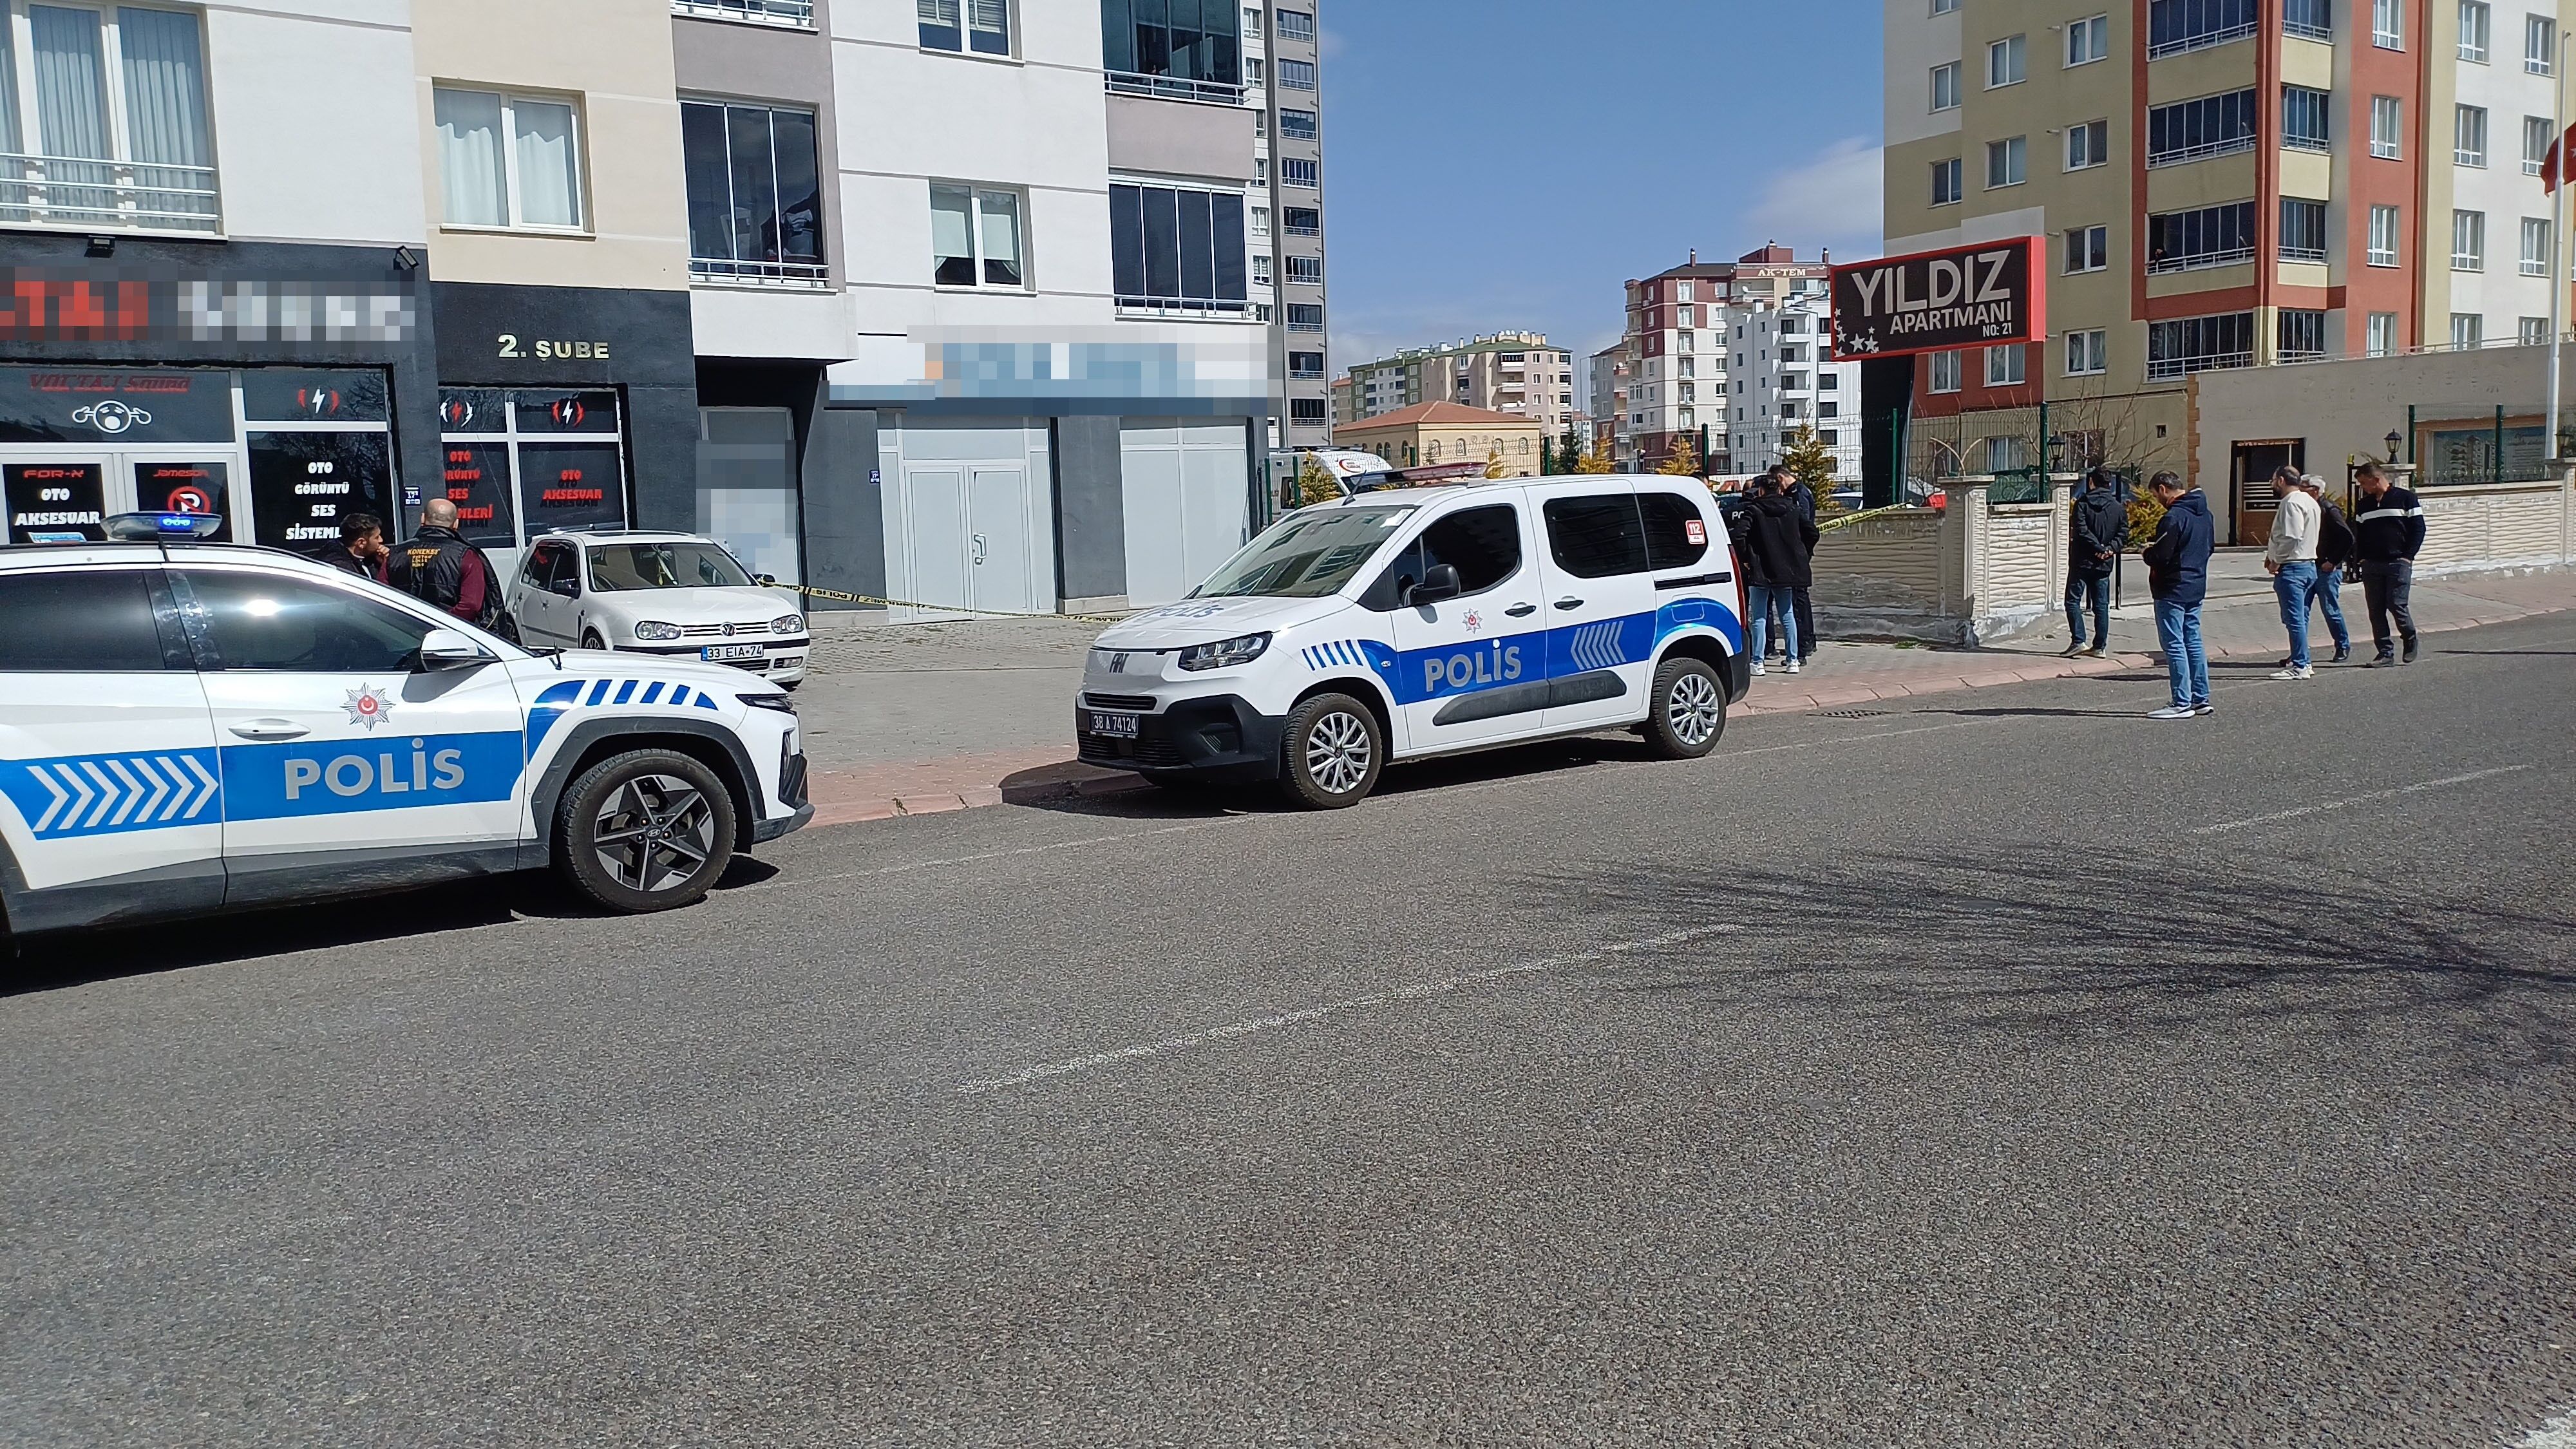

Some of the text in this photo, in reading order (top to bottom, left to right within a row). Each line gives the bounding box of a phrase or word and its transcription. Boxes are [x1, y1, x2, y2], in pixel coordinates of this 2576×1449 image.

[1757, 267, 1806, 277] AK-TEM
[1852, 250, 2011, 317] YILDIZ
[1889, 301, 2011, 335] APARTMANI
[1982, 322, 2012, 337] NO: 21
[498, 334, 609, 361] 2. ŞUBE
[449, 450, 471, 462] OTO
[308, 462, 333, 473] OTO
[443, 468, 480, 480] RÜNTÜ
[560, 469, 582, 480] OTO
[41, 488, 70, 500] OTO
[294, 482, 350, 495] GÖRÜNTÜ
[448, 488, 469, 499] SES
[542, 488, 602, 500] AKSESUAR
[311, 504, 336, 516] SES
[457, 504, 493, 518] MLERİ
[15, 511, 101, 526] AKSESUAR
[285, 523, 343, 540] SİSTEML
[1688, 523, 1701, 535] 112
[707, 648, 721, 658] 33
[1424, 639, 1521, 692] POLİS
[1094, 715, 1136, 733] 38 A 74124
[284, 737, 464, 800] POLİS
